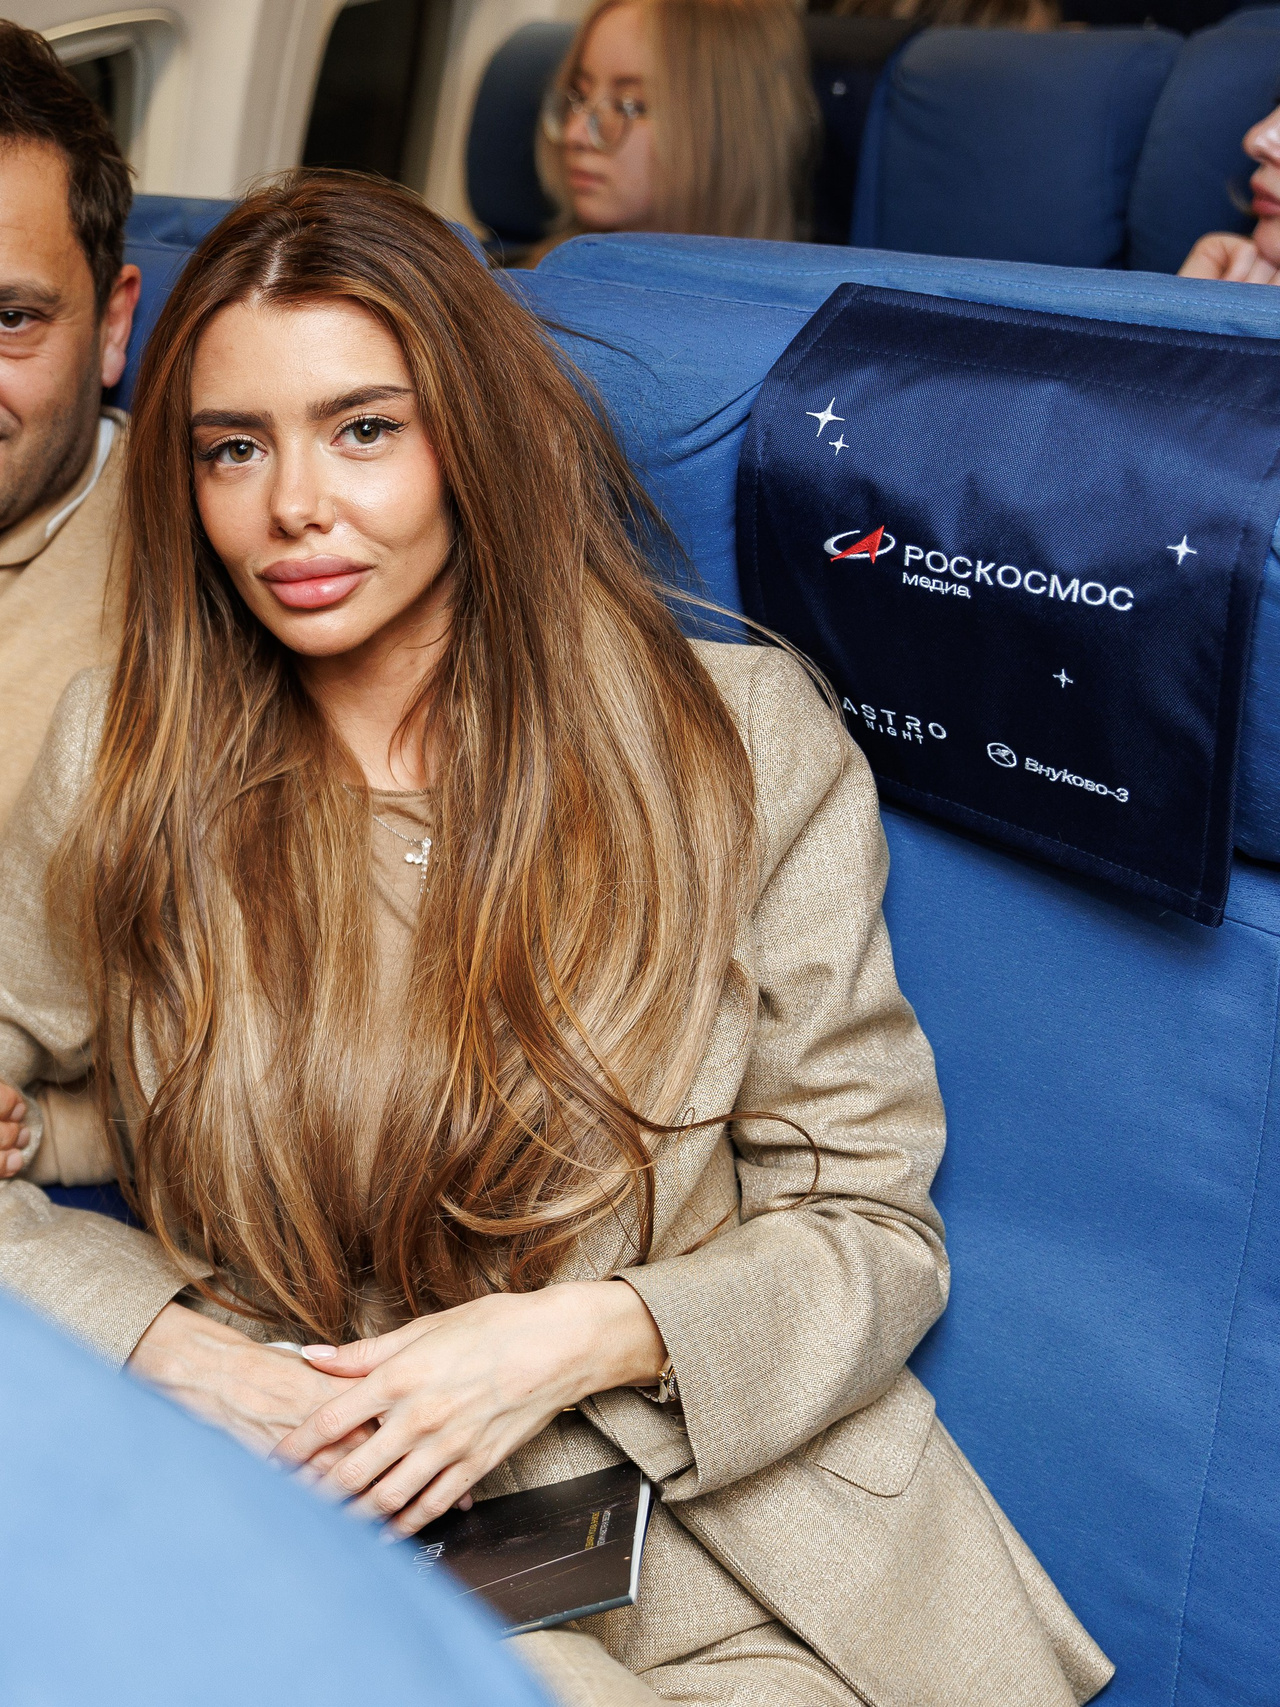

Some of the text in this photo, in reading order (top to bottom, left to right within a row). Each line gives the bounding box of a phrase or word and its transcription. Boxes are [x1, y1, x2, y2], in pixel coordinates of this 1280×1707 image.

[902, 571, 972, 600] медиа
[903, 544, 1135, 612] РОСКОСМОС
[842, 696, 947, 740] ASTRO
[865, 719, 924, 745] NIGHT
[1024, 757, 1130, 803] Внуково-3
